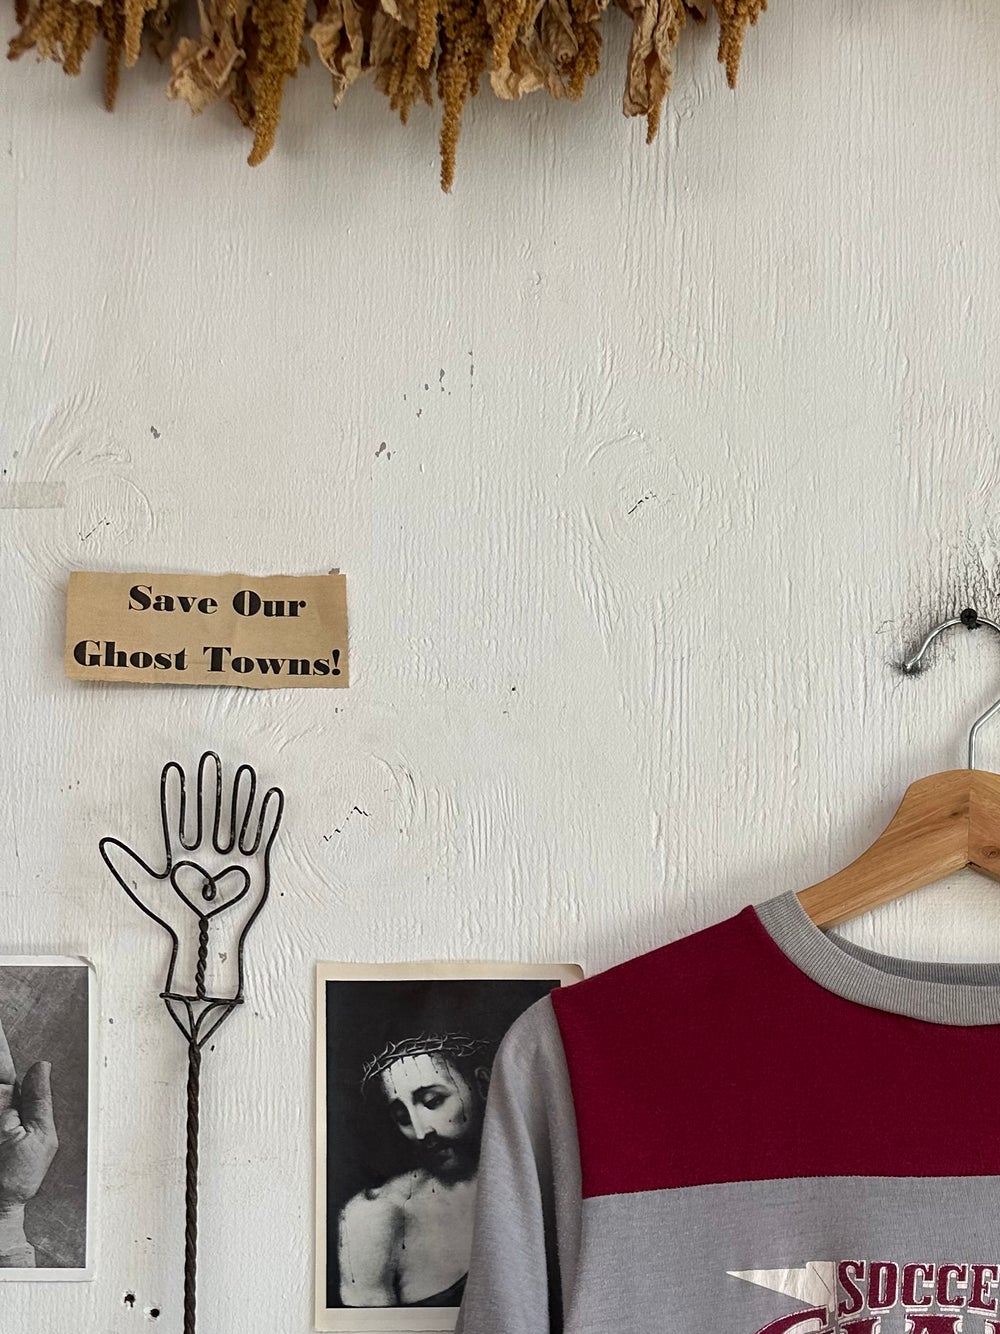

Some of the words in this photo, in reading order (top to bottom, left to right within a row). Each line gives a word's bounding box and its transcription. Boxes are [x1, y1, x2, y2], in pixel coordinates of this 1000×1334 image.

[128, 585, 218, 614] Save
[232, 590, 306, 617] Our
[73, 640, 189, 671] Ghost
[203, 646, 341, 676] Towns!
